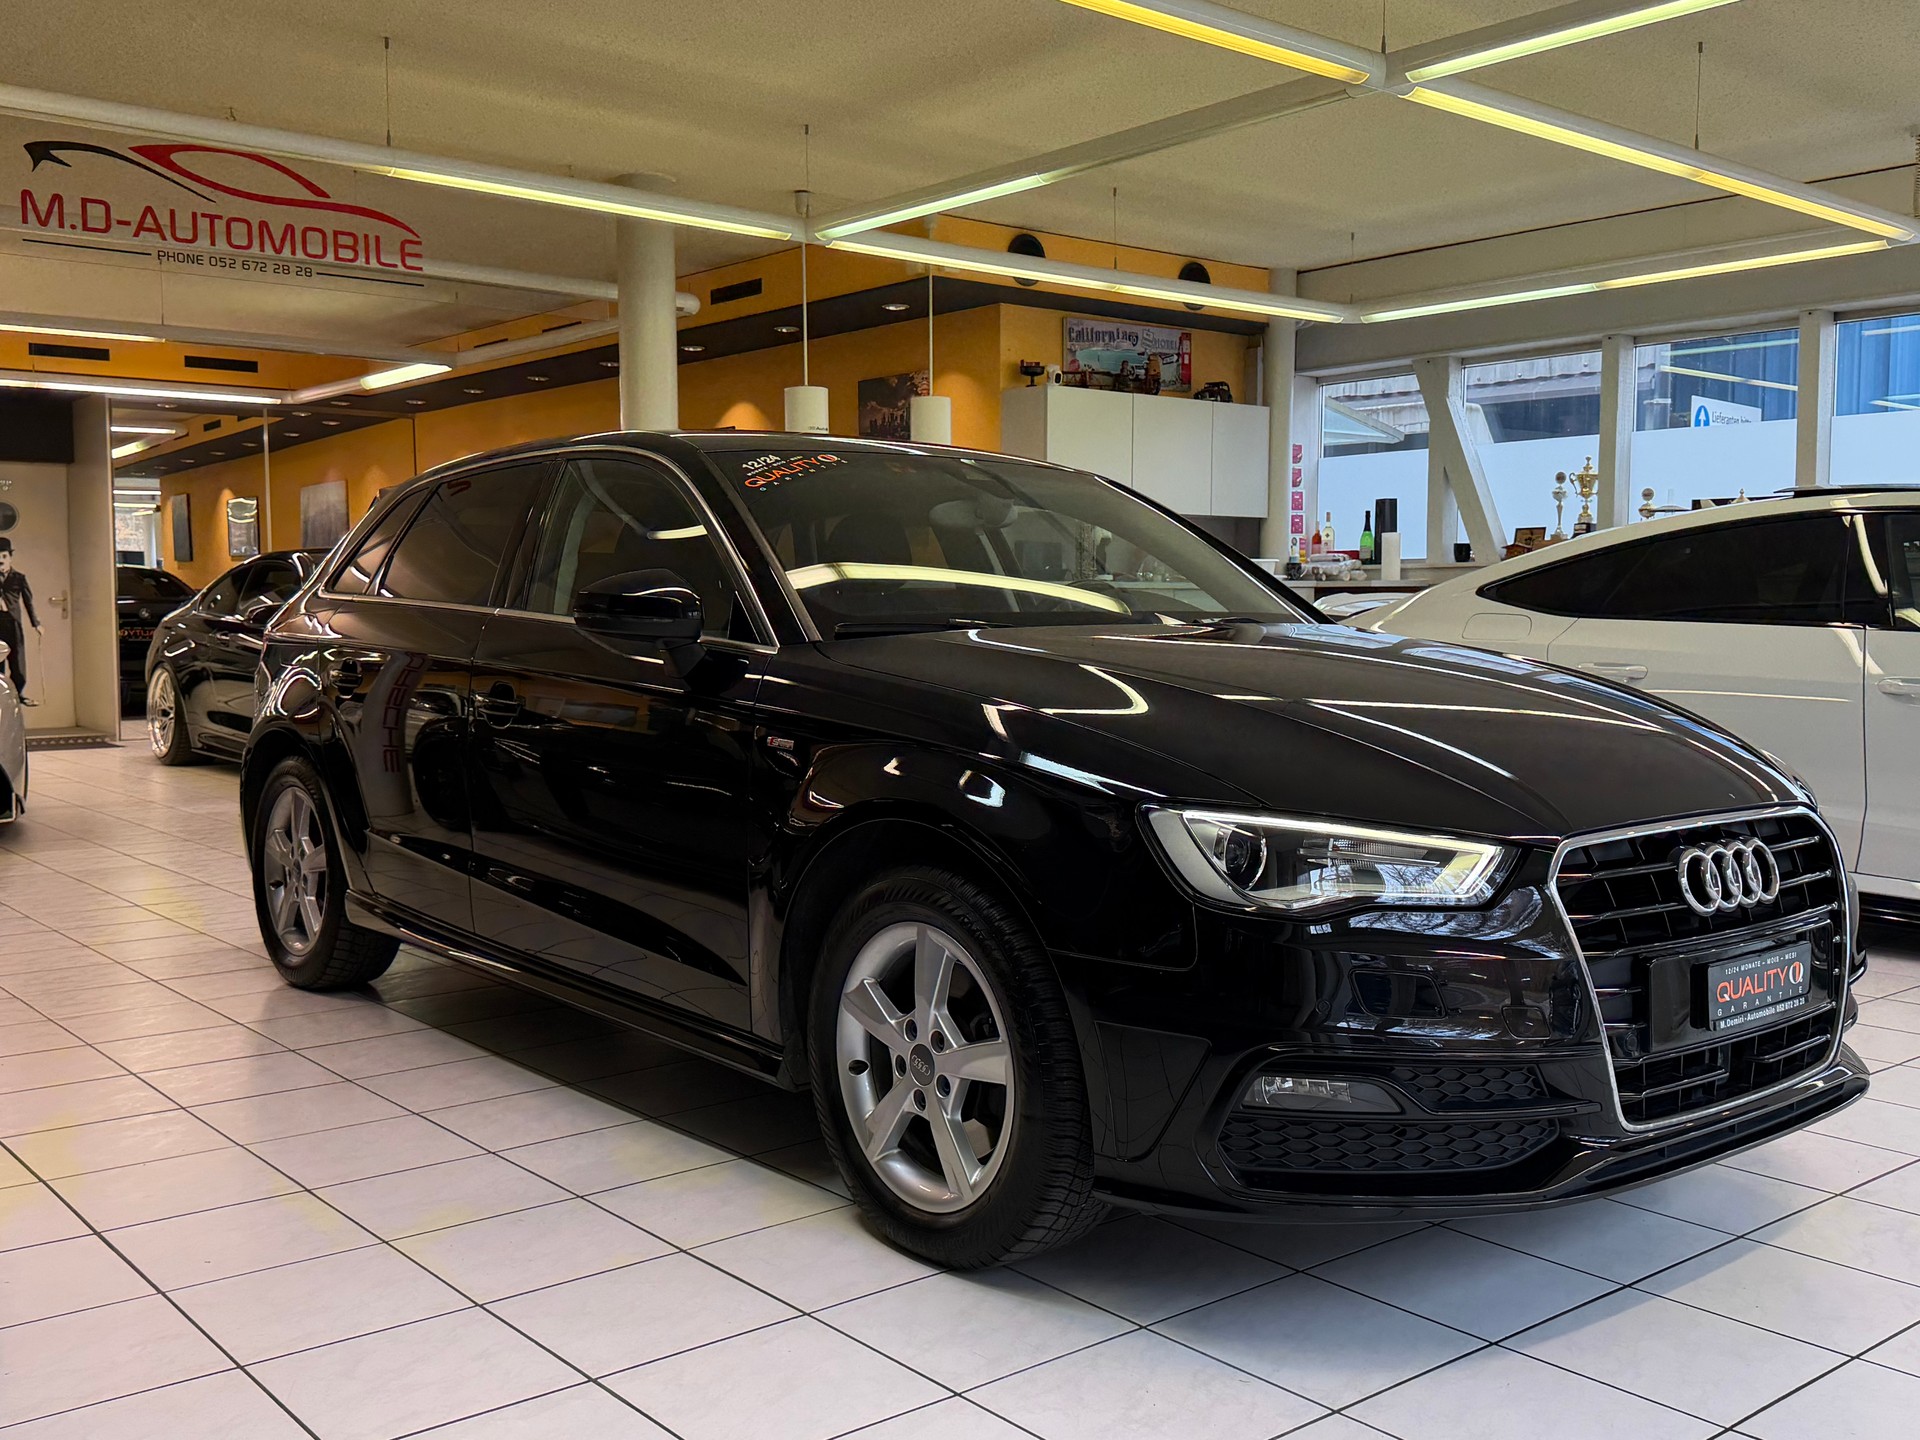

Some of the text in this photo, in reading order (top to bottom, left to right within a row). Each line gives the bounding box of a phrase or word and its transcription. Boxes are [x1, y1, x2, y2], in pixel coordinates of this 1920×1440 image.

[20, 188, 424, 271] M.D-AUTOMOBILE
[157, 250, 314, 278] PHONE 052 672 28 28
[742, 454, 781, 469] 12/24
[744, 457, 820, 487] QUALITY
[1717, 965, 1789, 1003] QUALITY
[1717, 985, 1803, 1017] GARANTIE
